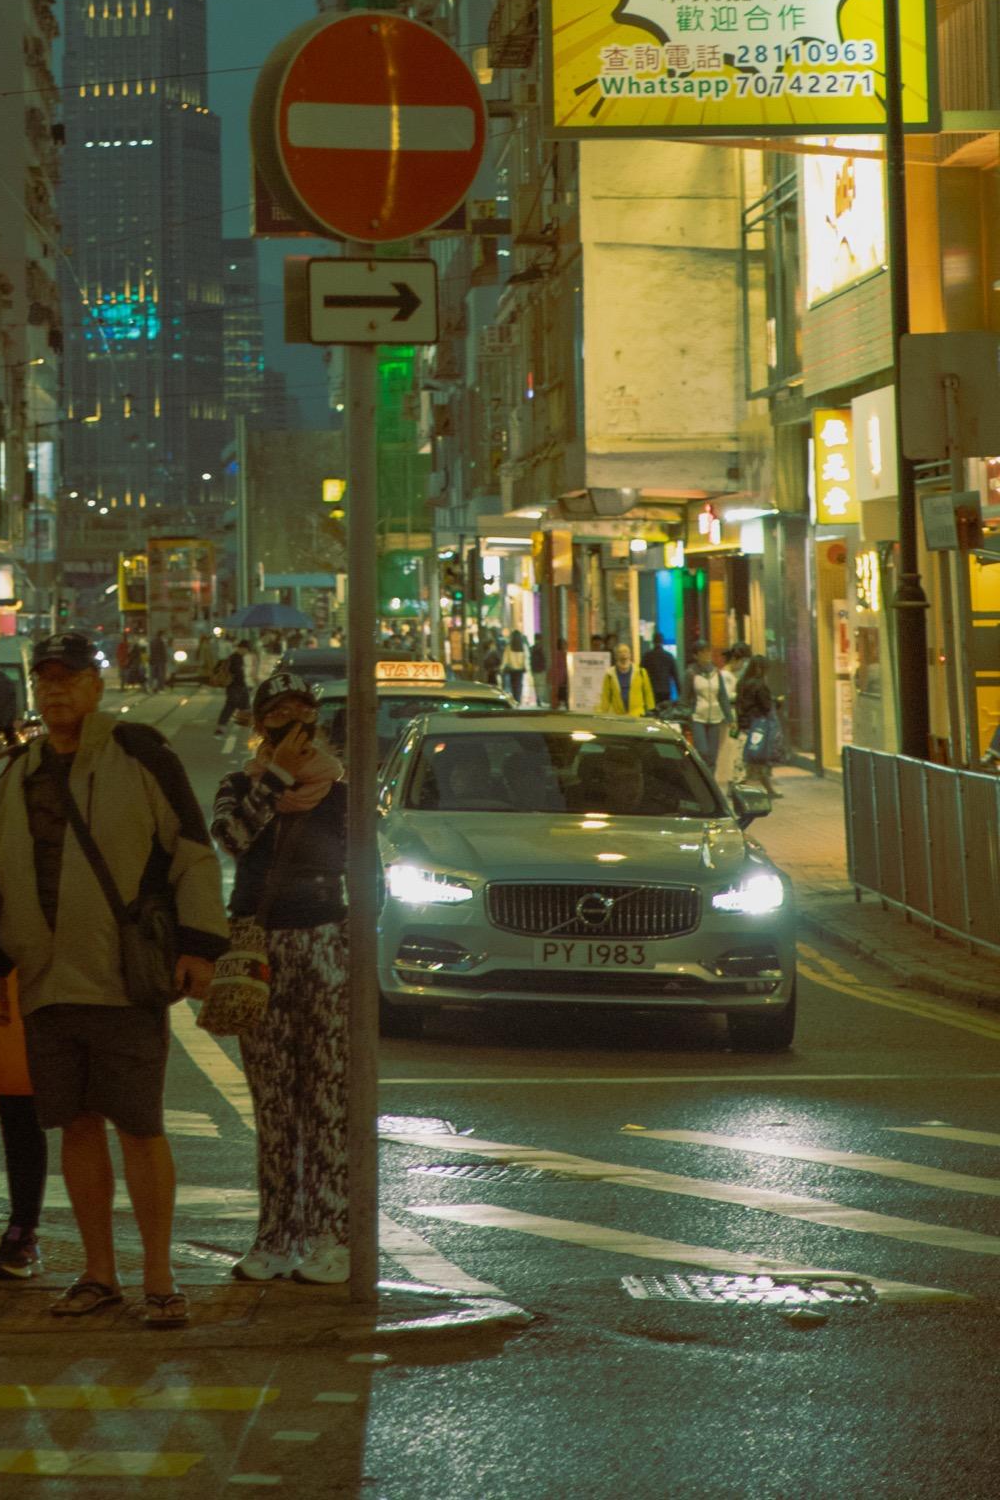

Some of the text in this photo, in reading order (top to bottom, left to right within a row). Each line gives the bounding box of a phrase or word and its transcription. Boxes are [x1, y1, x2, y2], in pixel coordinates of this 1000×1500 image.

[675, 5, 807, 33] 歡迎合作
[602, 43, 876, 73] 查詢電話 28110963
[602, 75, 874, 99] Whatsapp 70742271
[380, 663, 440, 677] TAXI
[542, 942, 646, 965] PY 1983
